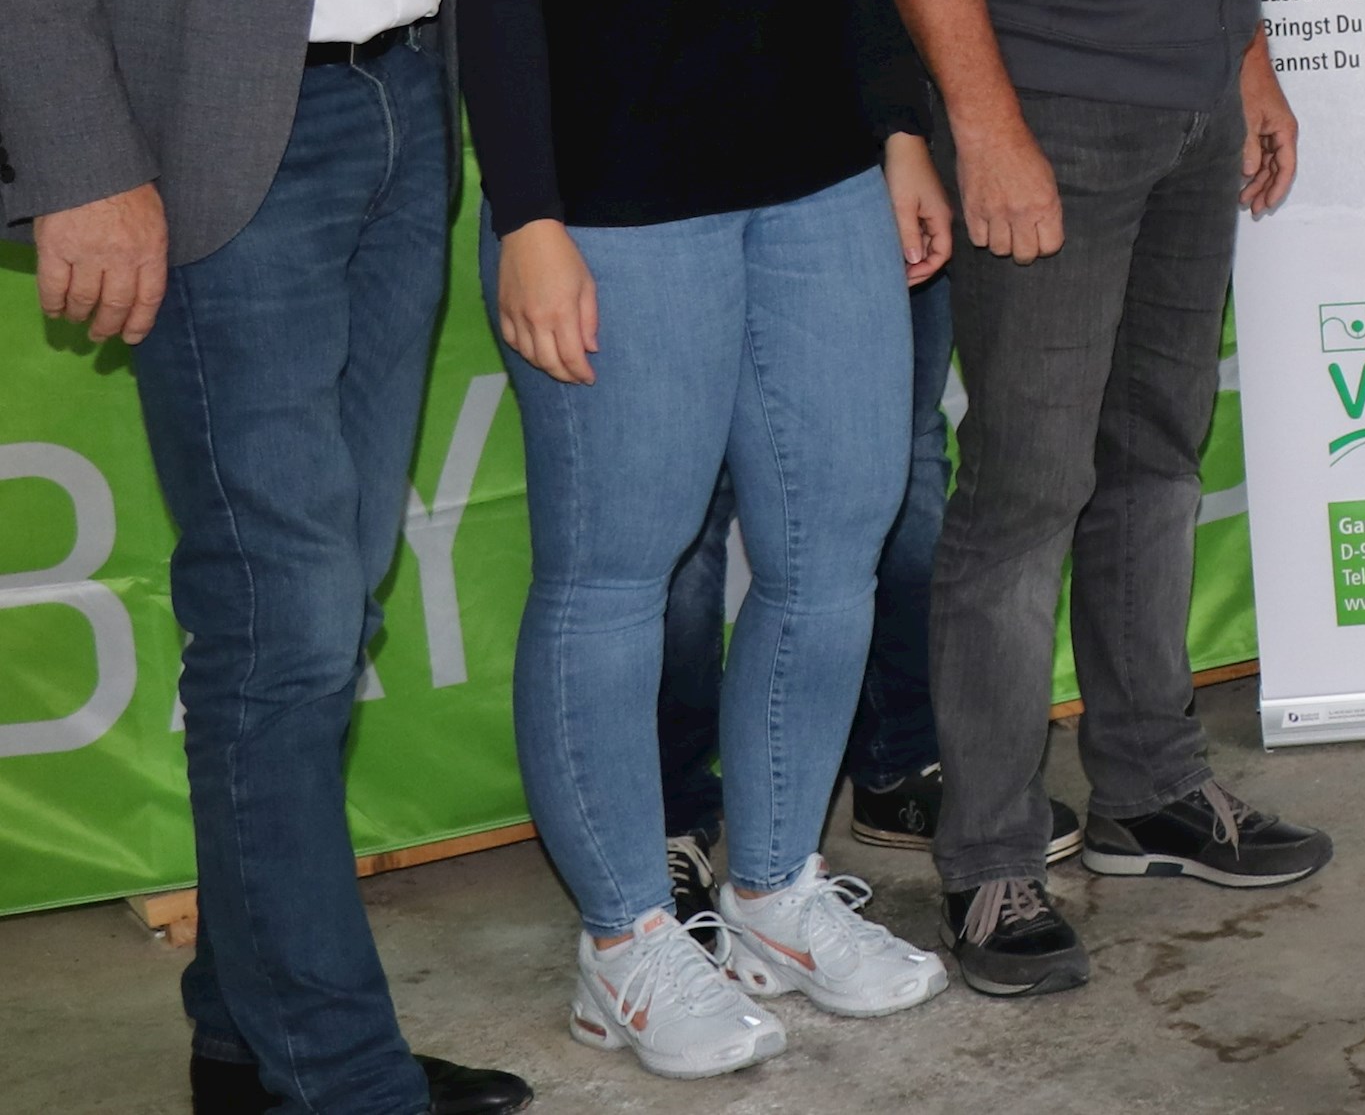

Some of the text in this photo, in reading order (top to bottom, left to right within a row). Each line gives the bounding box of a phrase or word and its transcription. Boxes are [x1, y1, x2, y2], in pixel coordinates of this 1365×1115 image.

[1337, 15, 1361, 33] Du
[1270, 53, 1328, 72] annst
[1335, 51, 1359, 68] Du
